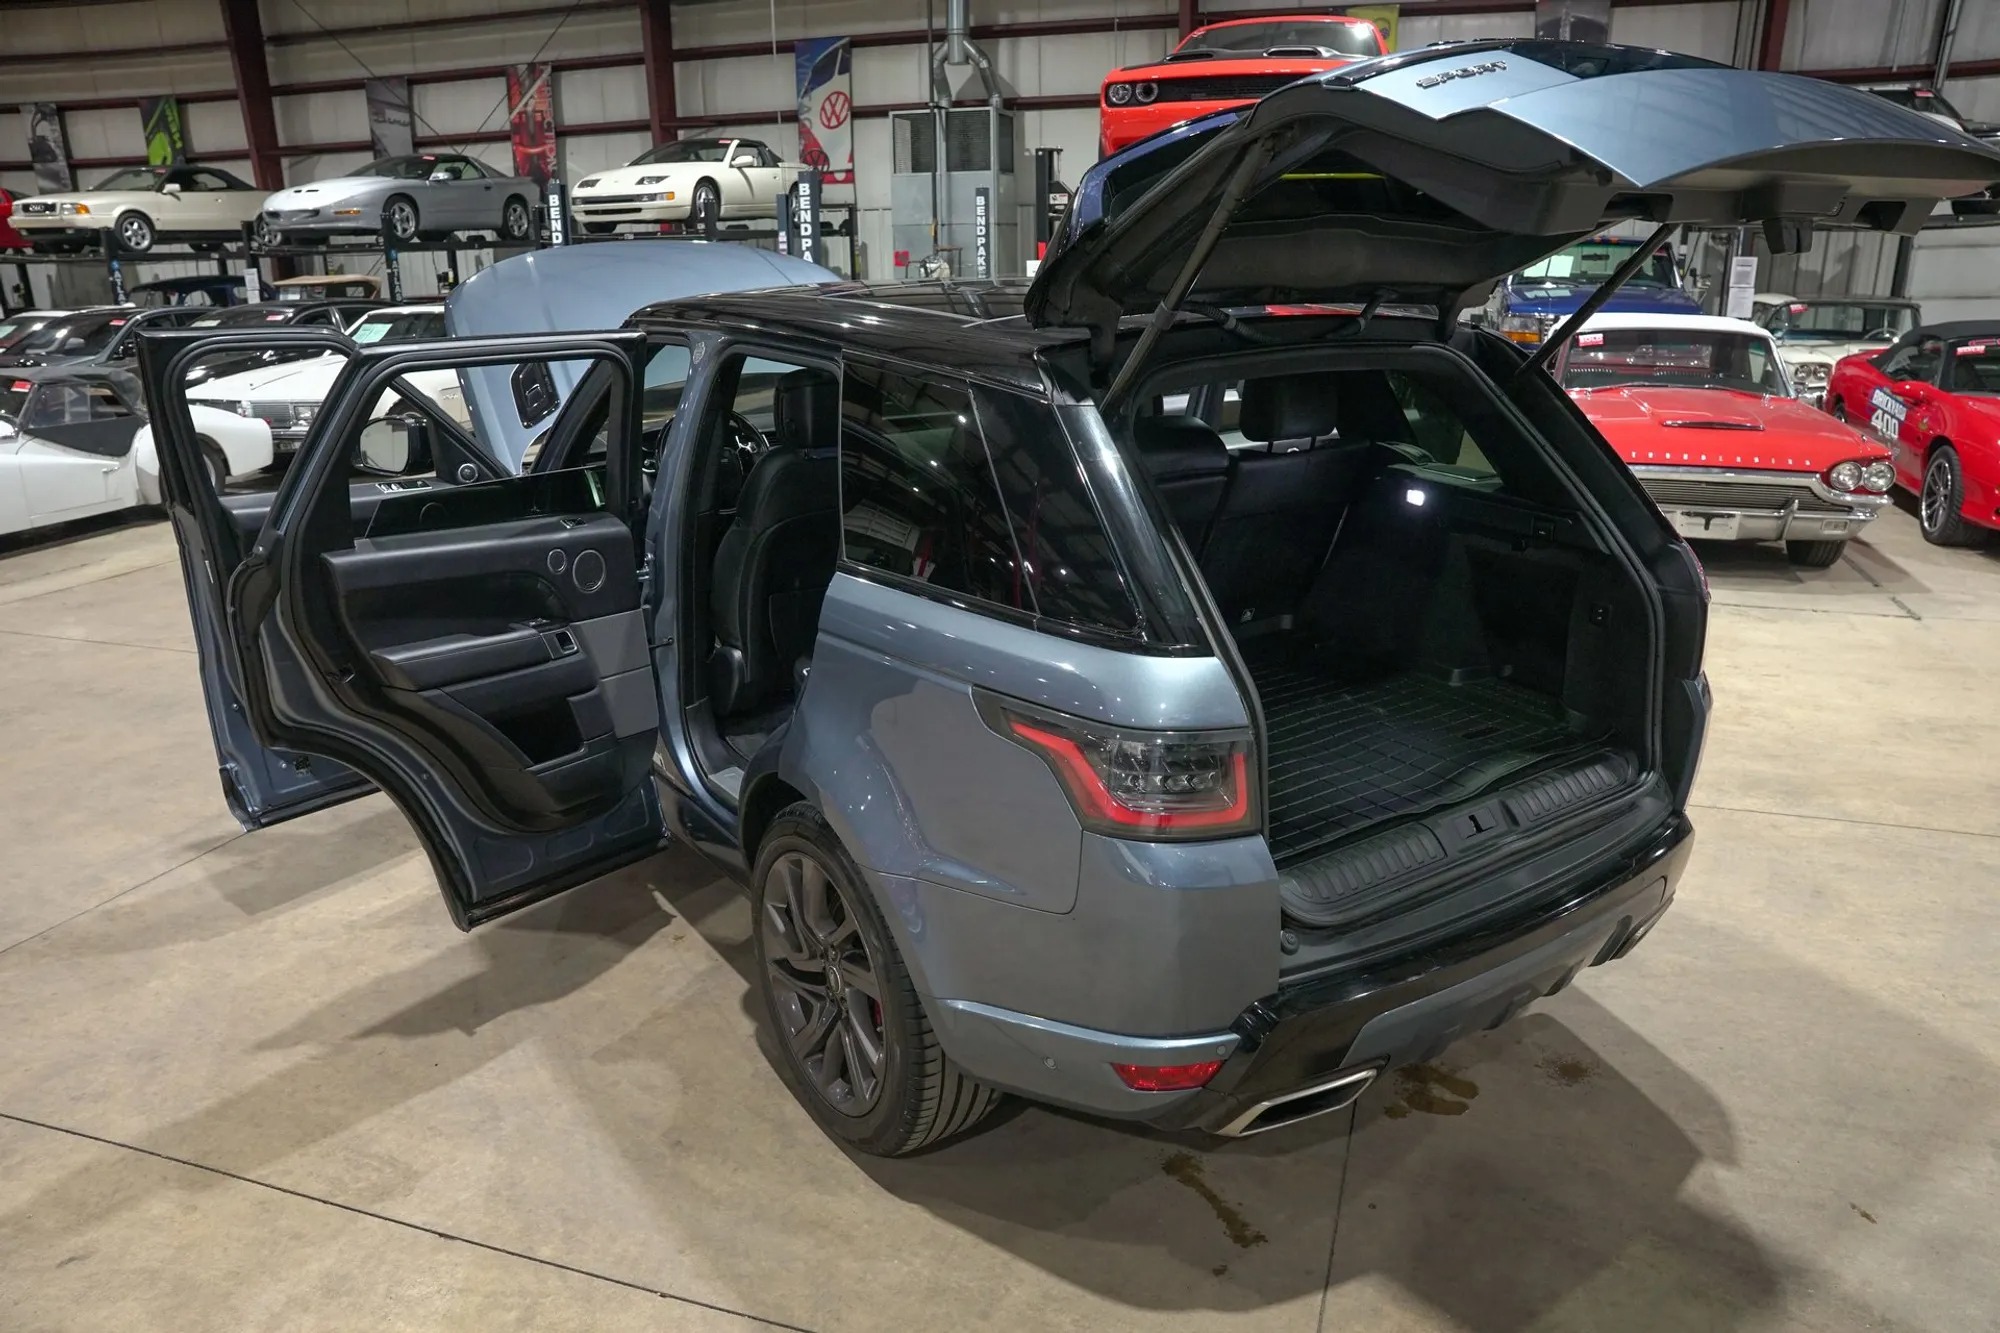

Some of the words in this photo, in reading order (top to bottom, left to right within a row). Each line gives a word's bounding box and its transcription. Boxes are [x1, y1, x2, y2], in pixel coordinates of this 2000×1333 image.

[549, 194, 563, 248] BEND
[976, 196, 986, 266] BENDPAK
[1871, 408, 1899, 439] 400
